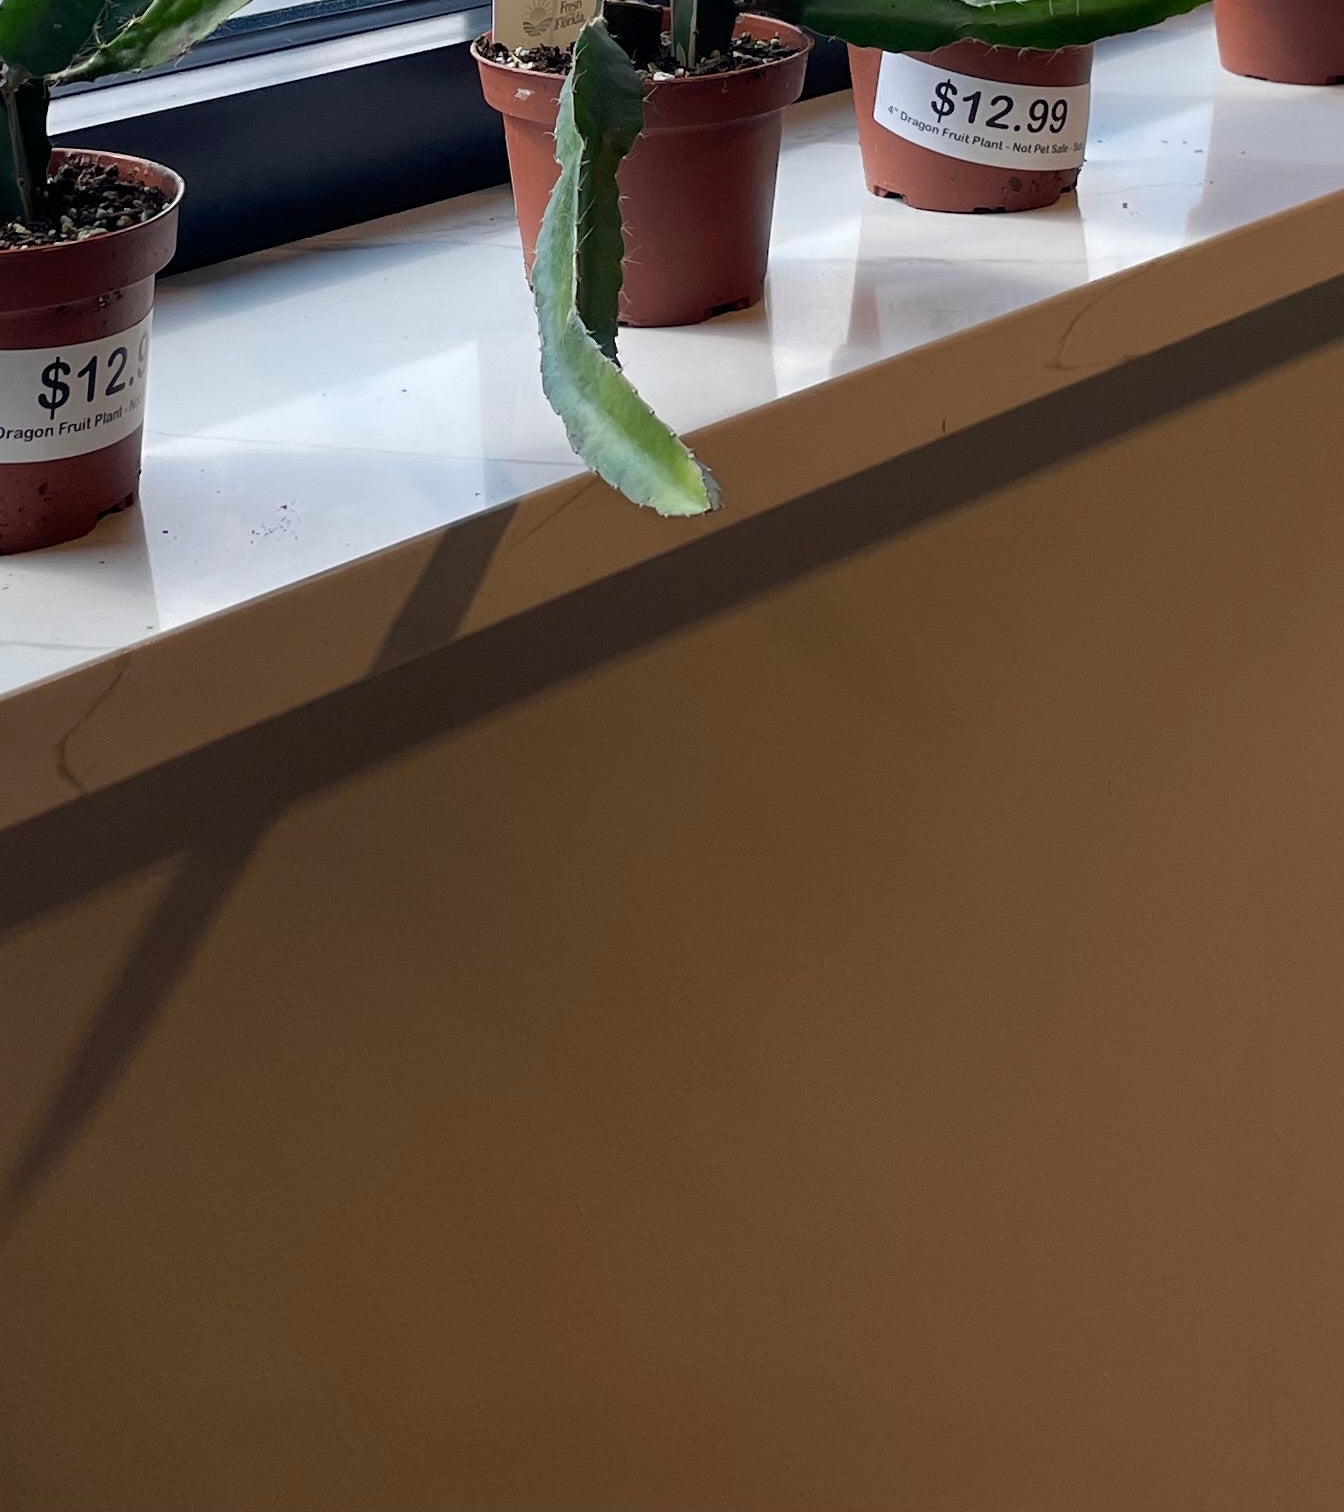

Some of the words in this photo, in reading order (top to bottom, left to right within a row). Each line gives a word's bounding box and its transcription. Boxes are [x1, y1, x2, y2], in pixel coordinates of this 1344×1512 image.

[931, 78, 1068, 133] $12.99
[900, 111, 940, 136] Dragon
[942, 127, 969, 144] Fruit
[972, 135, 1003, 151] Plant
[1012, 142, 1032, 154] Not
[1034, 143, 1050, 154] Pet
[1052, 143, 1069, 154] Safe
[59, 417, 91, 435] Fruit
[95, 407, 123, 428] Plant
